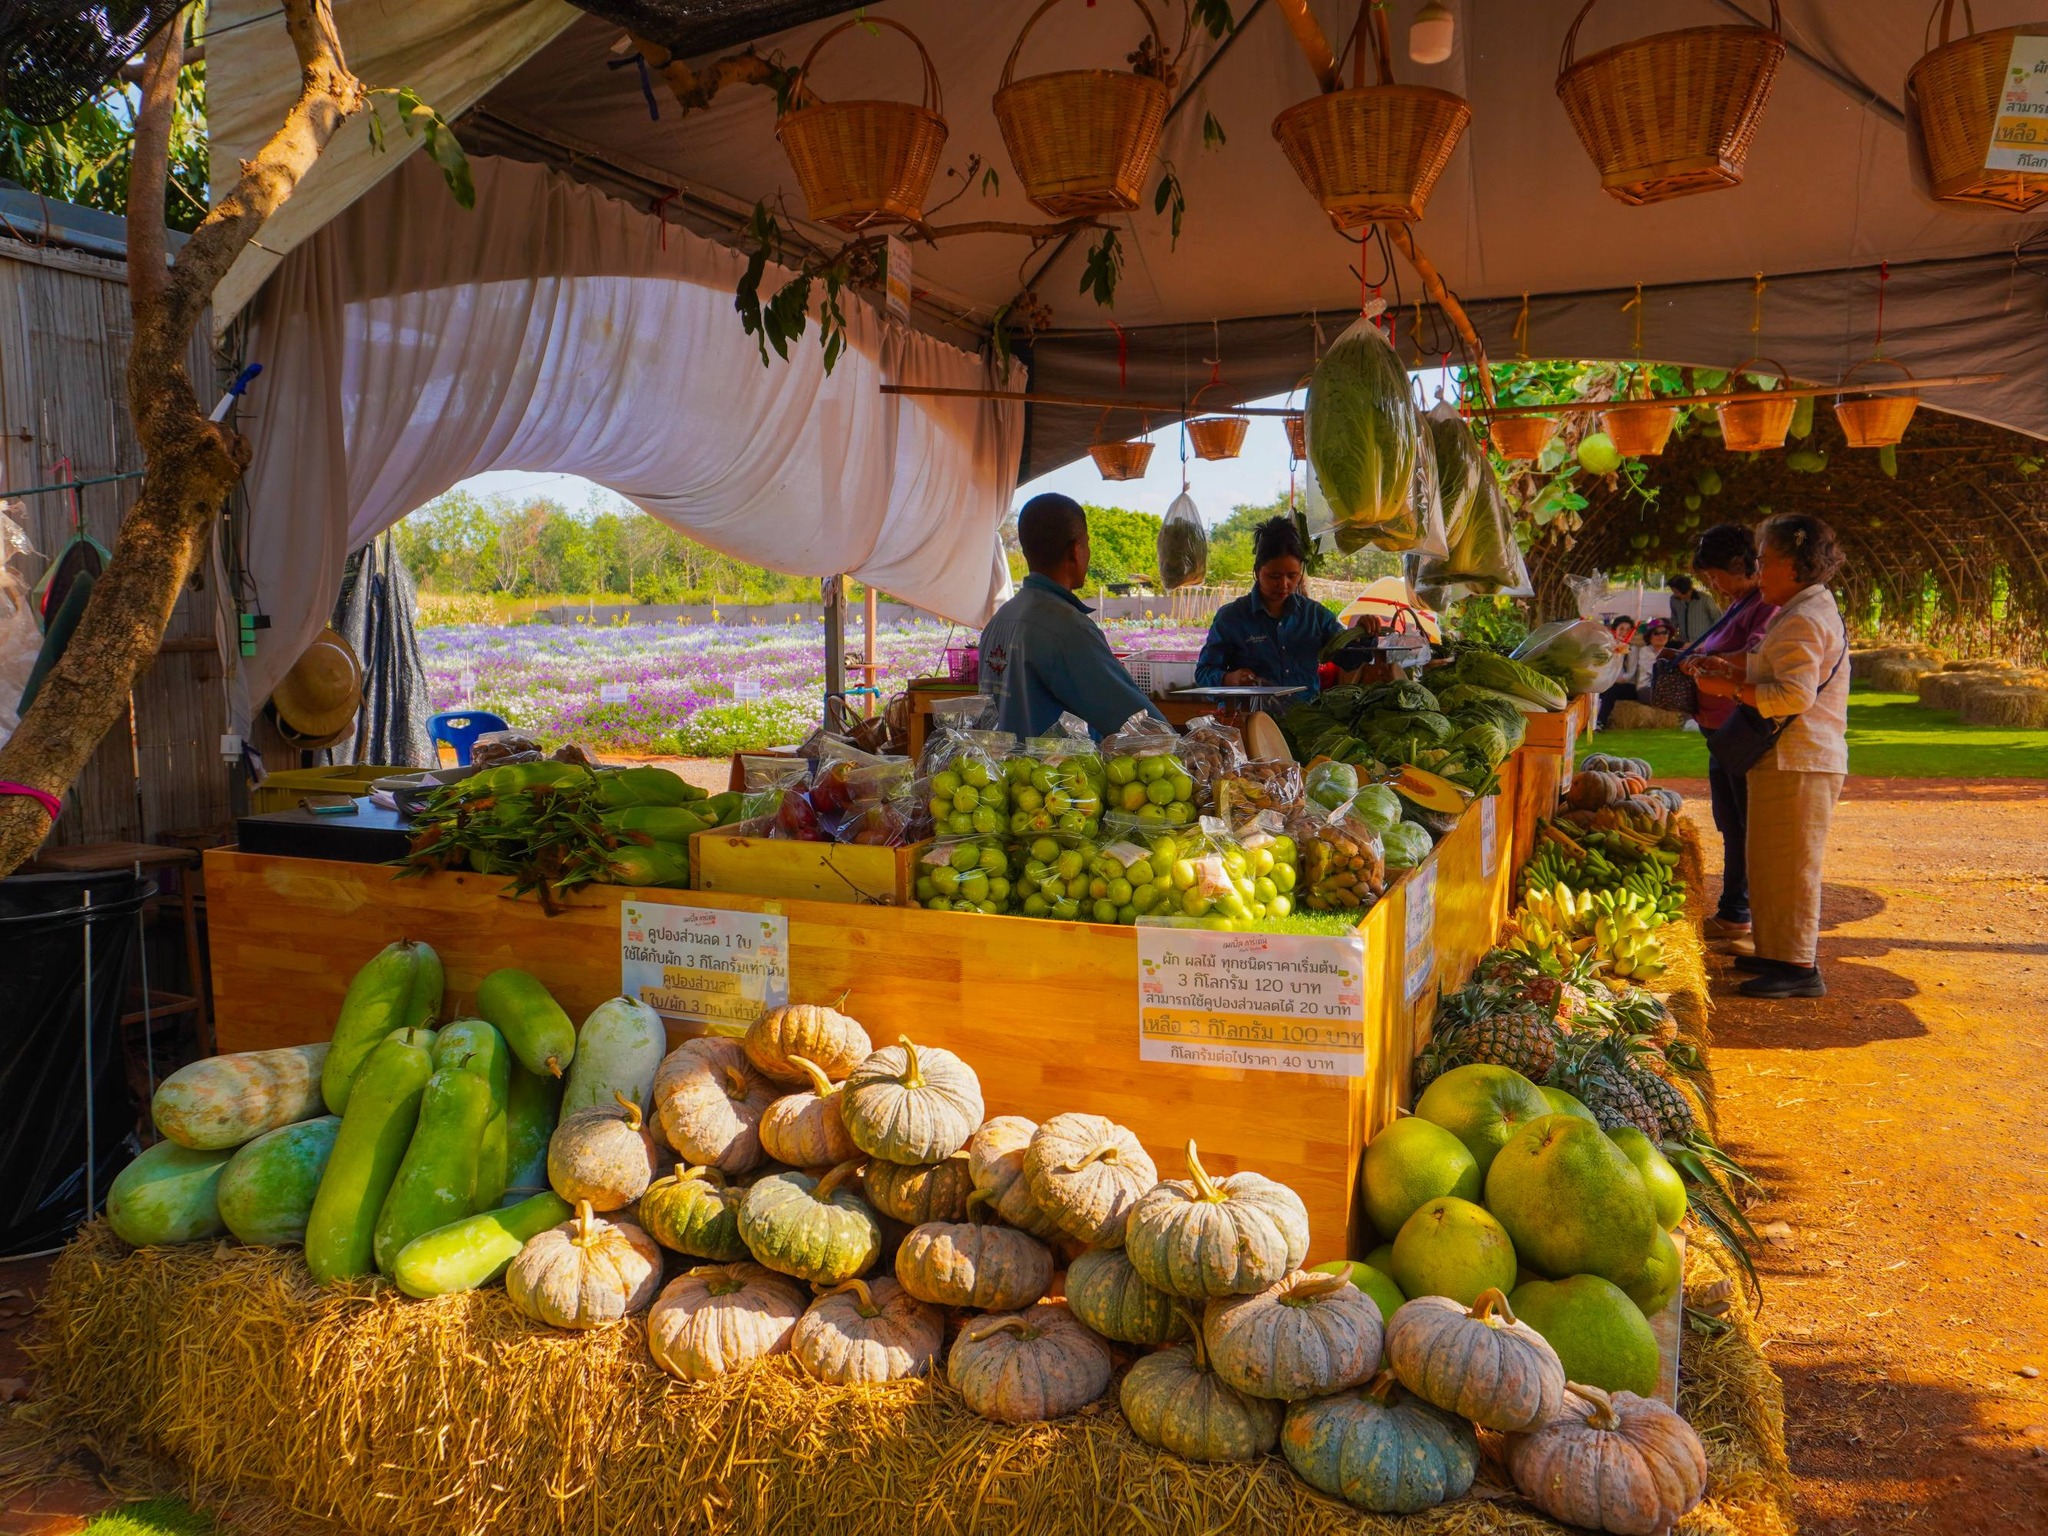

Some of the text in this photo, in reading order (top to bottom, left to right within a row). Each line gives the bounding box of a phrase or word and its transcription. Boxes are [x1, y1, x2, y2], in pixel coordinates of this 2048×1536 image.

[1995, 122, 2037, 141] เหลือ
[648, 926, 720, 946] คูปองส่วนลด
[725, 934, 731, 947] 1
[736, 934, 752, 949] ใบ
[623, 945, 785, 977] ใช้ได้กับผัก 3 กิโลกรัมเท่านั้น
[1162, 951, 1338, 974] ผัก ผลไม้ ทุกชนิดราคาเริ่มต้น
[1178, 972, 1321, 994] 3 กิโลกรัม 120 บาท
[691, 999, 700, 1012] 3
[1146, 993, 1351, 1016] สามารถใช้คูปองส่วนลดได้ 20 บาท
[1142, 1013, 1364, 1045] เหลือ 3 กิโลกรัม 100 บาท
[1170, 1045, 1334, 1070] กิโลกรัมต่อไปราคา 40 บาท
